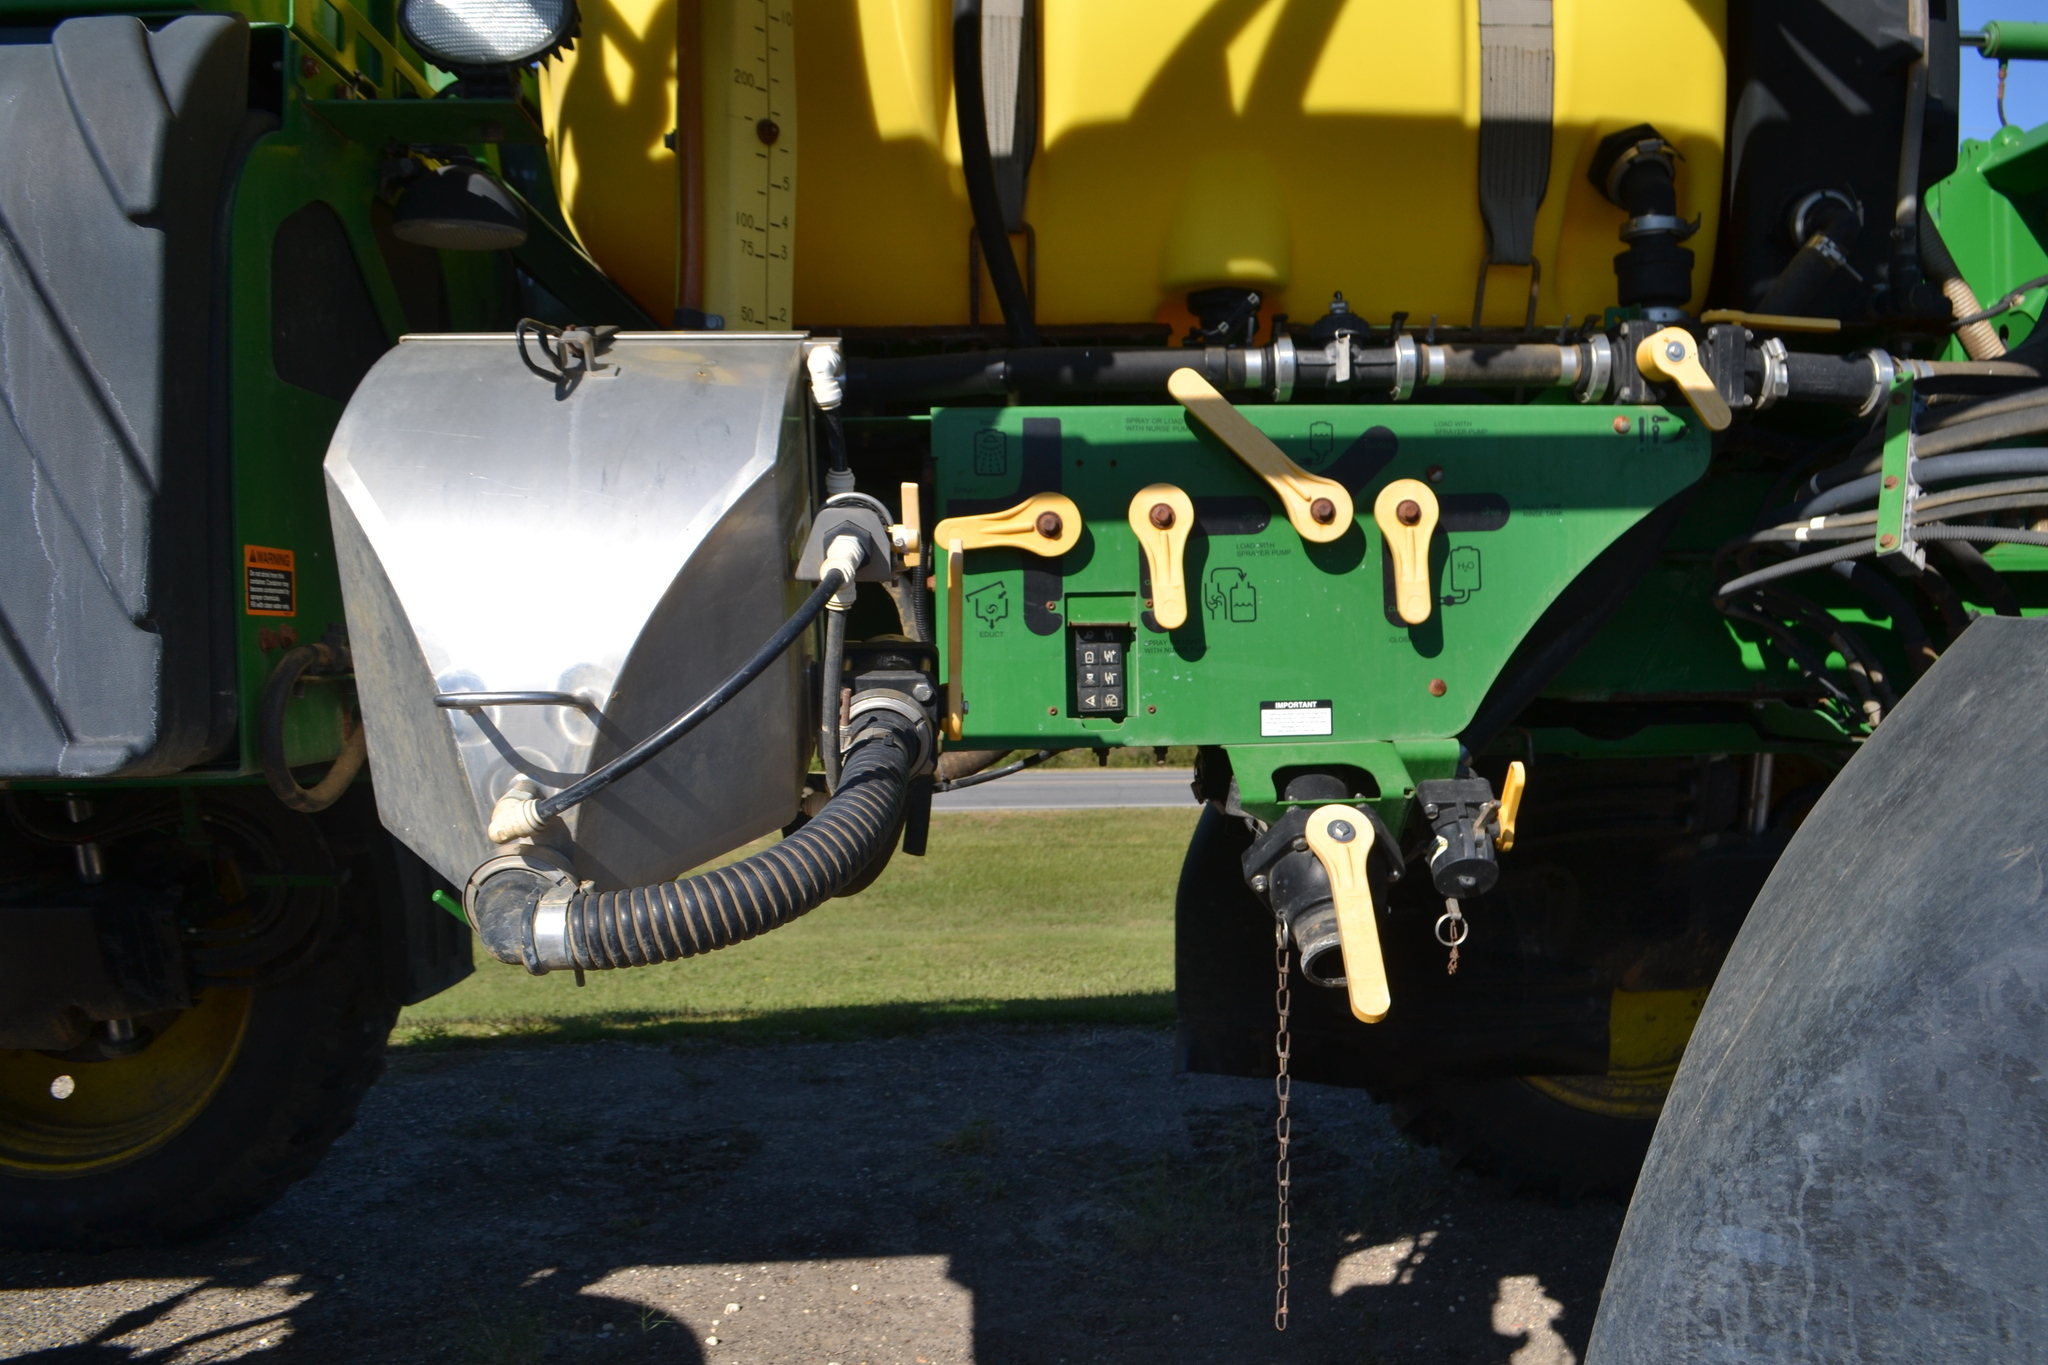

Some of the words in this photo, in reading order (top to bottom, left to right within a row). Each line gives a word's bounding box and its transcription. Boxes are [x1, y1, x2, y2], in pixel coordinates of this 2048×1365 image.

[781, 10, 793, 26] 10
[734, 68, 755, 87] 200
[782, 176, 791, 191] 5
[736, 210, 755, 229] 100
[781, 216, 789, 230] 4
[740, 239, 754, 256] 75
[780, 245, 788, 260] 3
[741, 306, 754, 323] 50
[779, 307, 788, 323] 2
[1271, 548, 1291, 556] PUMP
[1275, 701, 1318, 709] IMPORTANT
